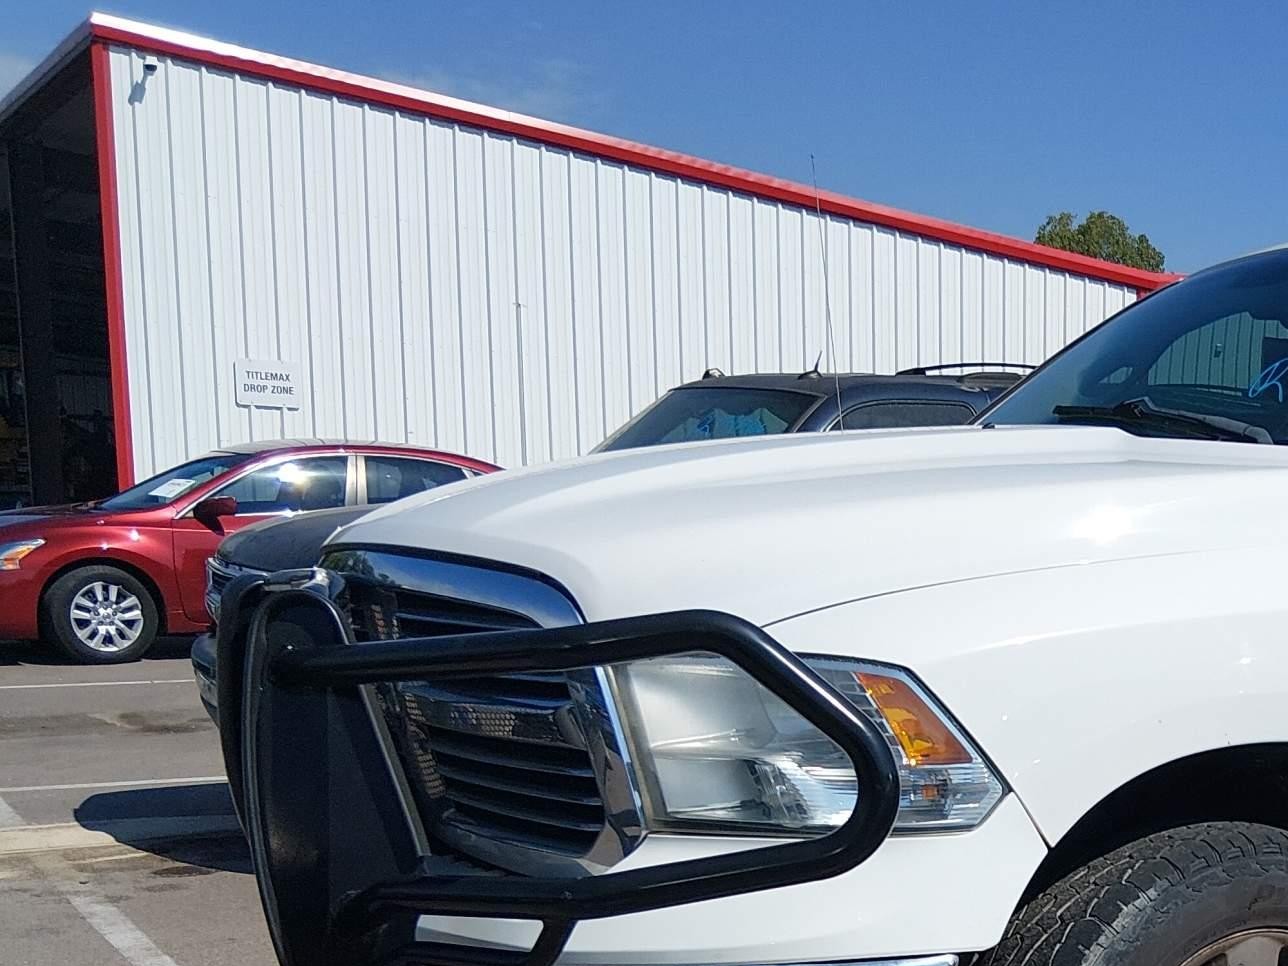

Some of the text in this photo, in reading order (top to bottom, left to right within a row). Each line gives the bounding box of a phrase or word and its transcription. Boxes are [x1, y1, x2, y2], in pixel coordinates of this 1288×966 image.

[246, 370, 290, 382] TITLEMAX
[243, 383, 295, 396] DROP ZONE
